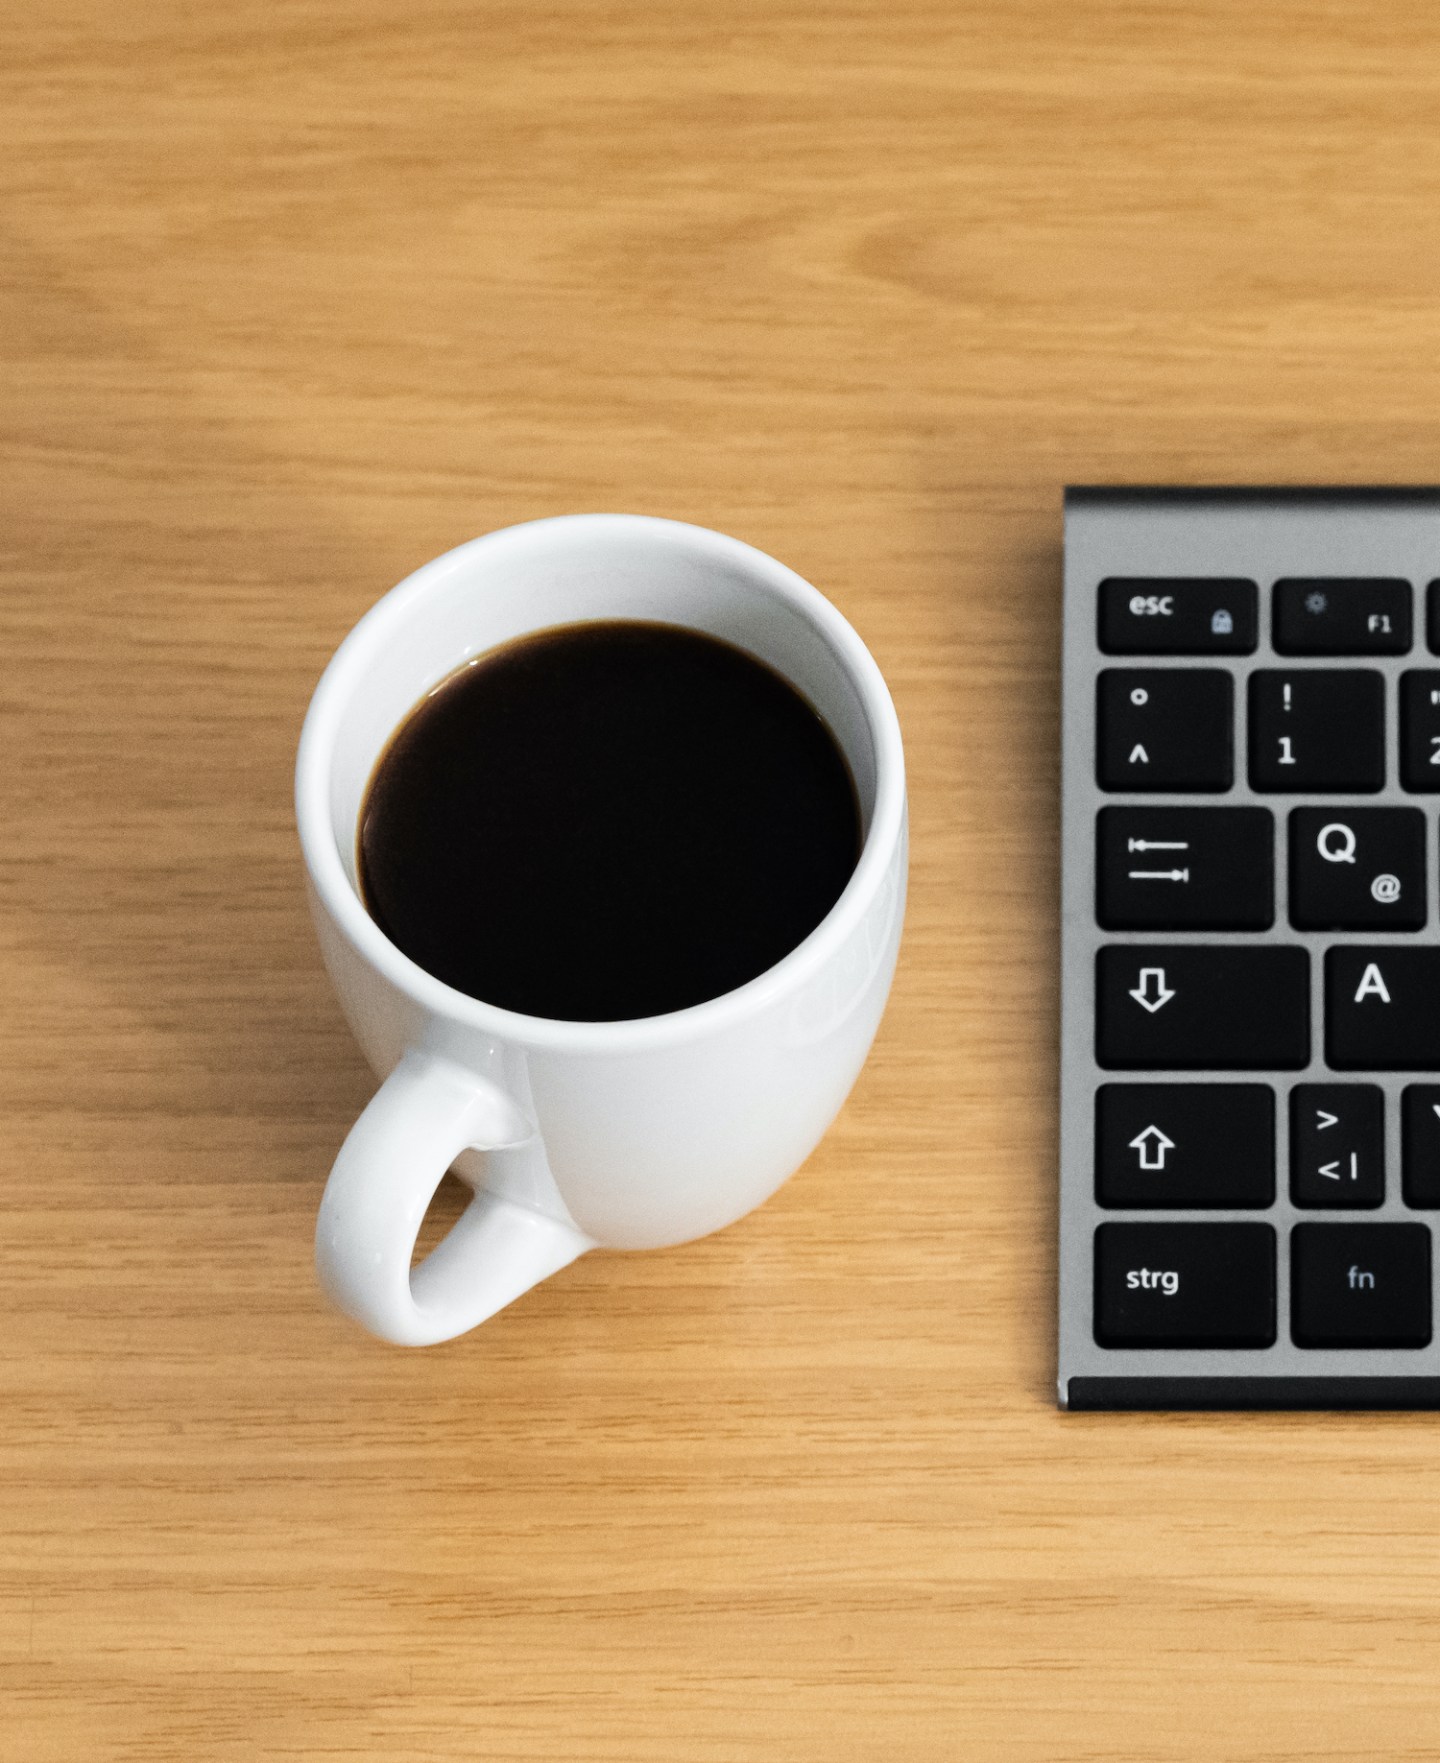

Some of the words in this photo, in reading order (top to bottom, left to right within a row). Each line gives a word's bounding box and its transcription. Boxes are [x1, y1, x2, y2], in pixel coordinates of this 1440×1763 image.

[1129, 596, 1172, 615] esc
[1368, 615, 1391, 632] F1
[1284, 684, 1291, 710] !
[1279, 737, 1295, 764] 1
[1317, 824, 1355, 863] Q
[1371, 874, 1400, 903] @
[1355, 964, 1390, 1002] A
[1317, 1111, 1338, 1129] >
[1318, 1161, 1339, 1179] <
[1127, 1268, 1178, 1295] strg
[1348, 1266, 1374, 1288] fn
